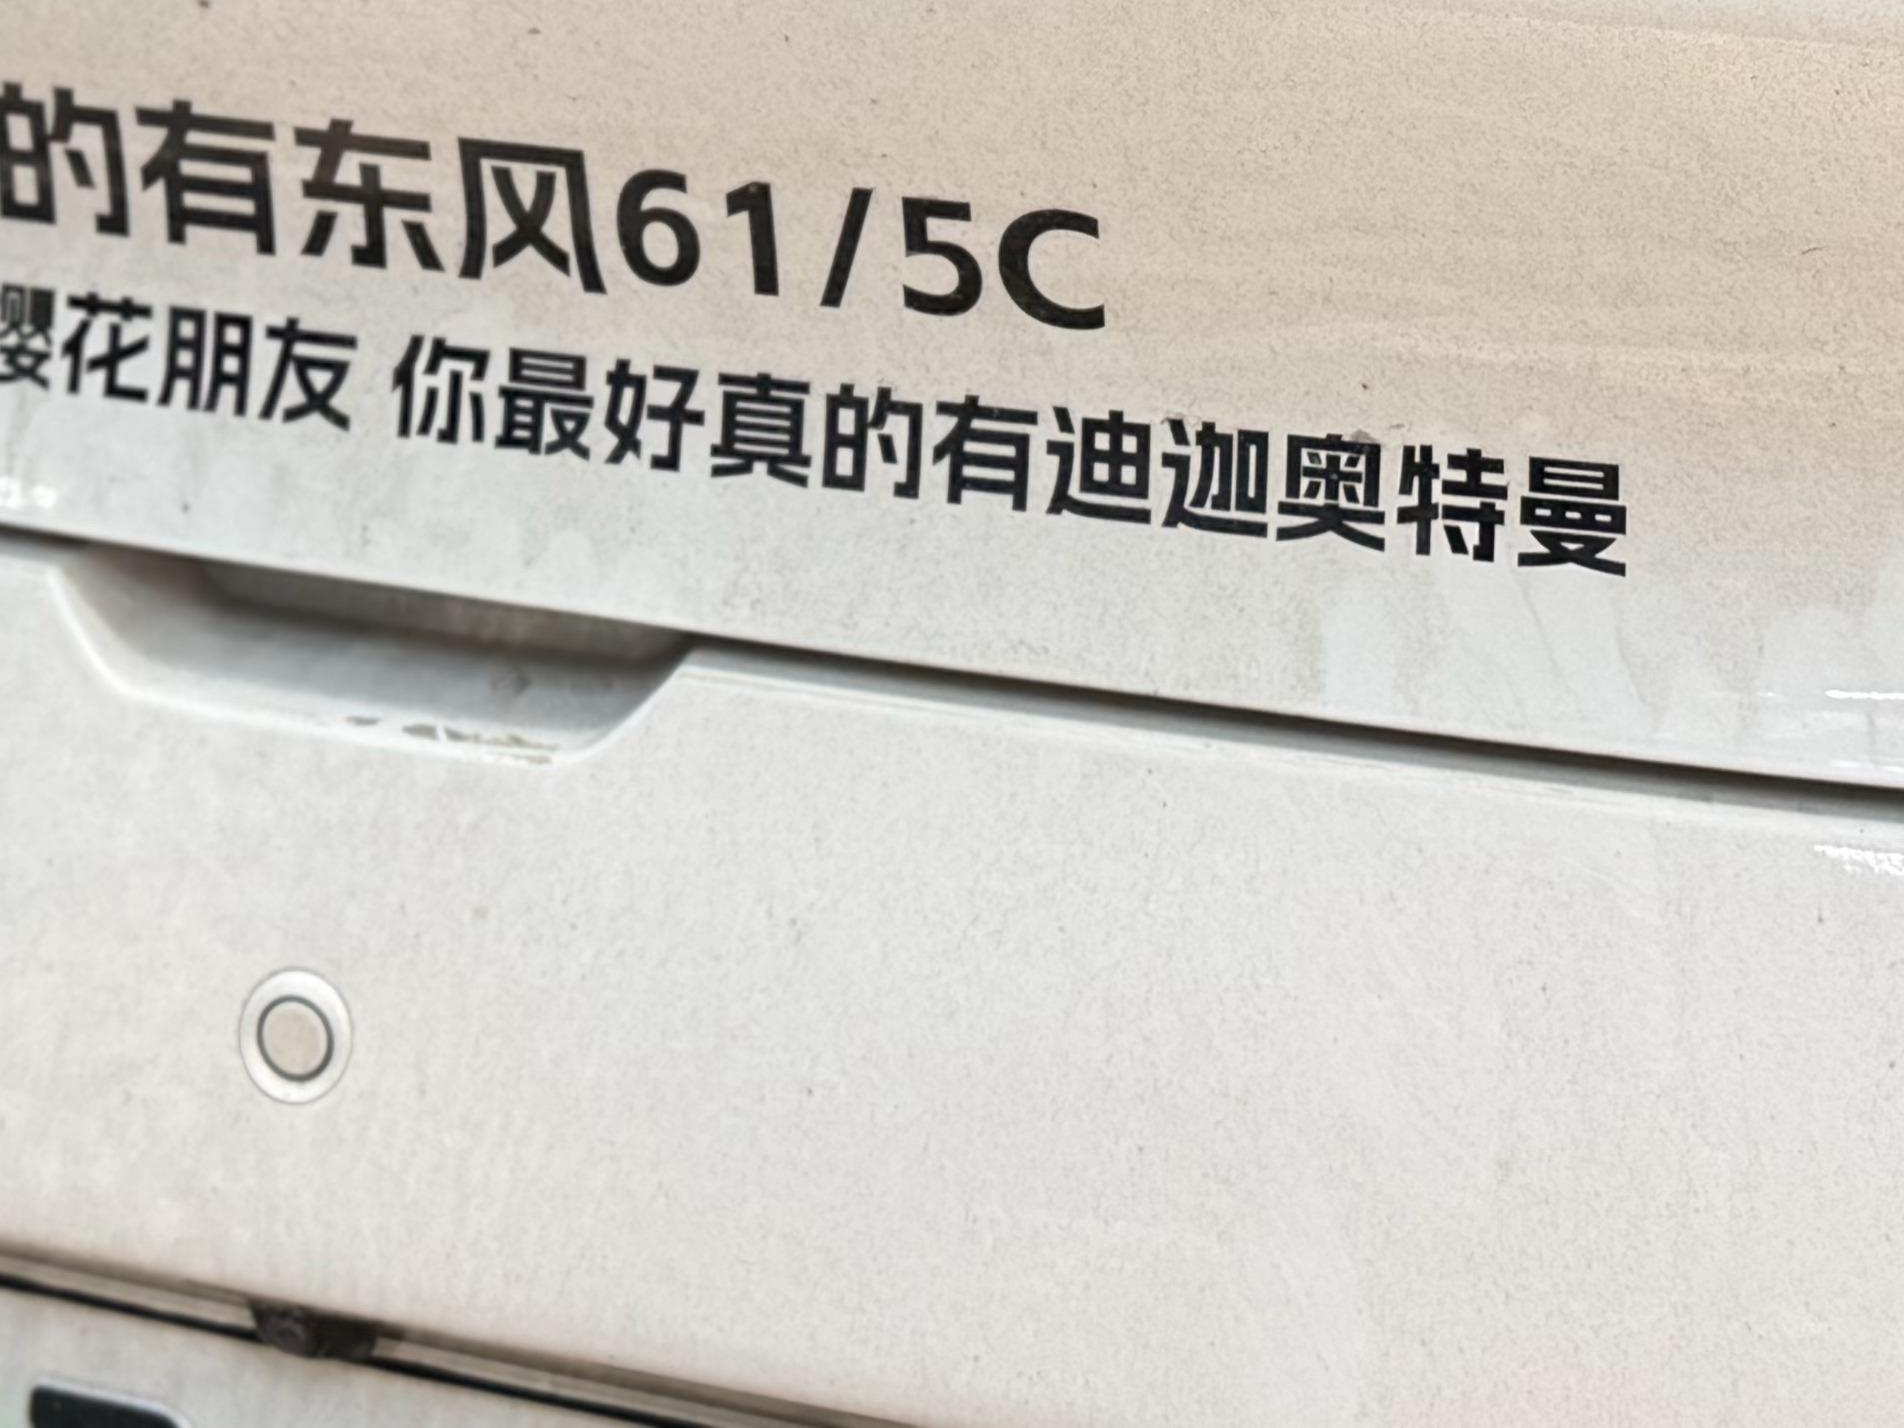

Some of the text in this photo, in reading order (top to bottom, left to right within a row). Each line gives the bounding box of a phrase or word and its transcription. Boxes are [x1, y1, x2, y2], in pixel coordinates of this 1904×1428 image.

[392, 334, 1628, 578] 你最好真的有迪迦奥特曼
